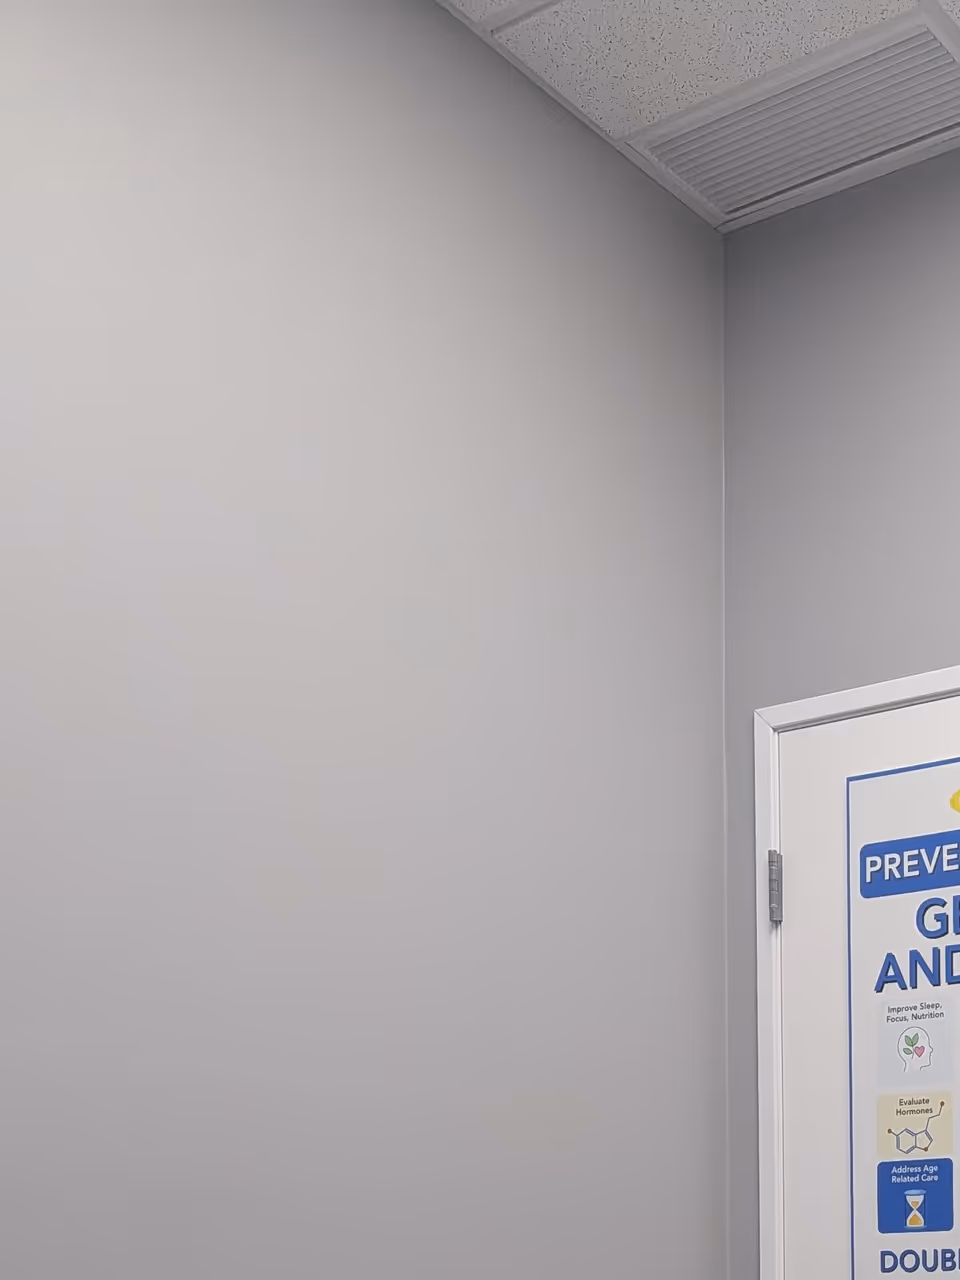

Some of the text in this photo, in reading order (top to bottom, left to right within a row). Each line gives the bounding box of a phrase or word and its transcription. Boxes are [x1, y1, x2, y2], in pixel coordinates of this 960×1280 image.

[888, 1002, 942, 1013] Improve Sleep,
[912, 1011, 944, 1020] Nutrition
[896, 1098, 933, 1116] Evaluate Hormones
[891, 1165, 938, 1173] Address Age
[892, 1175, 919, 1183] Related
